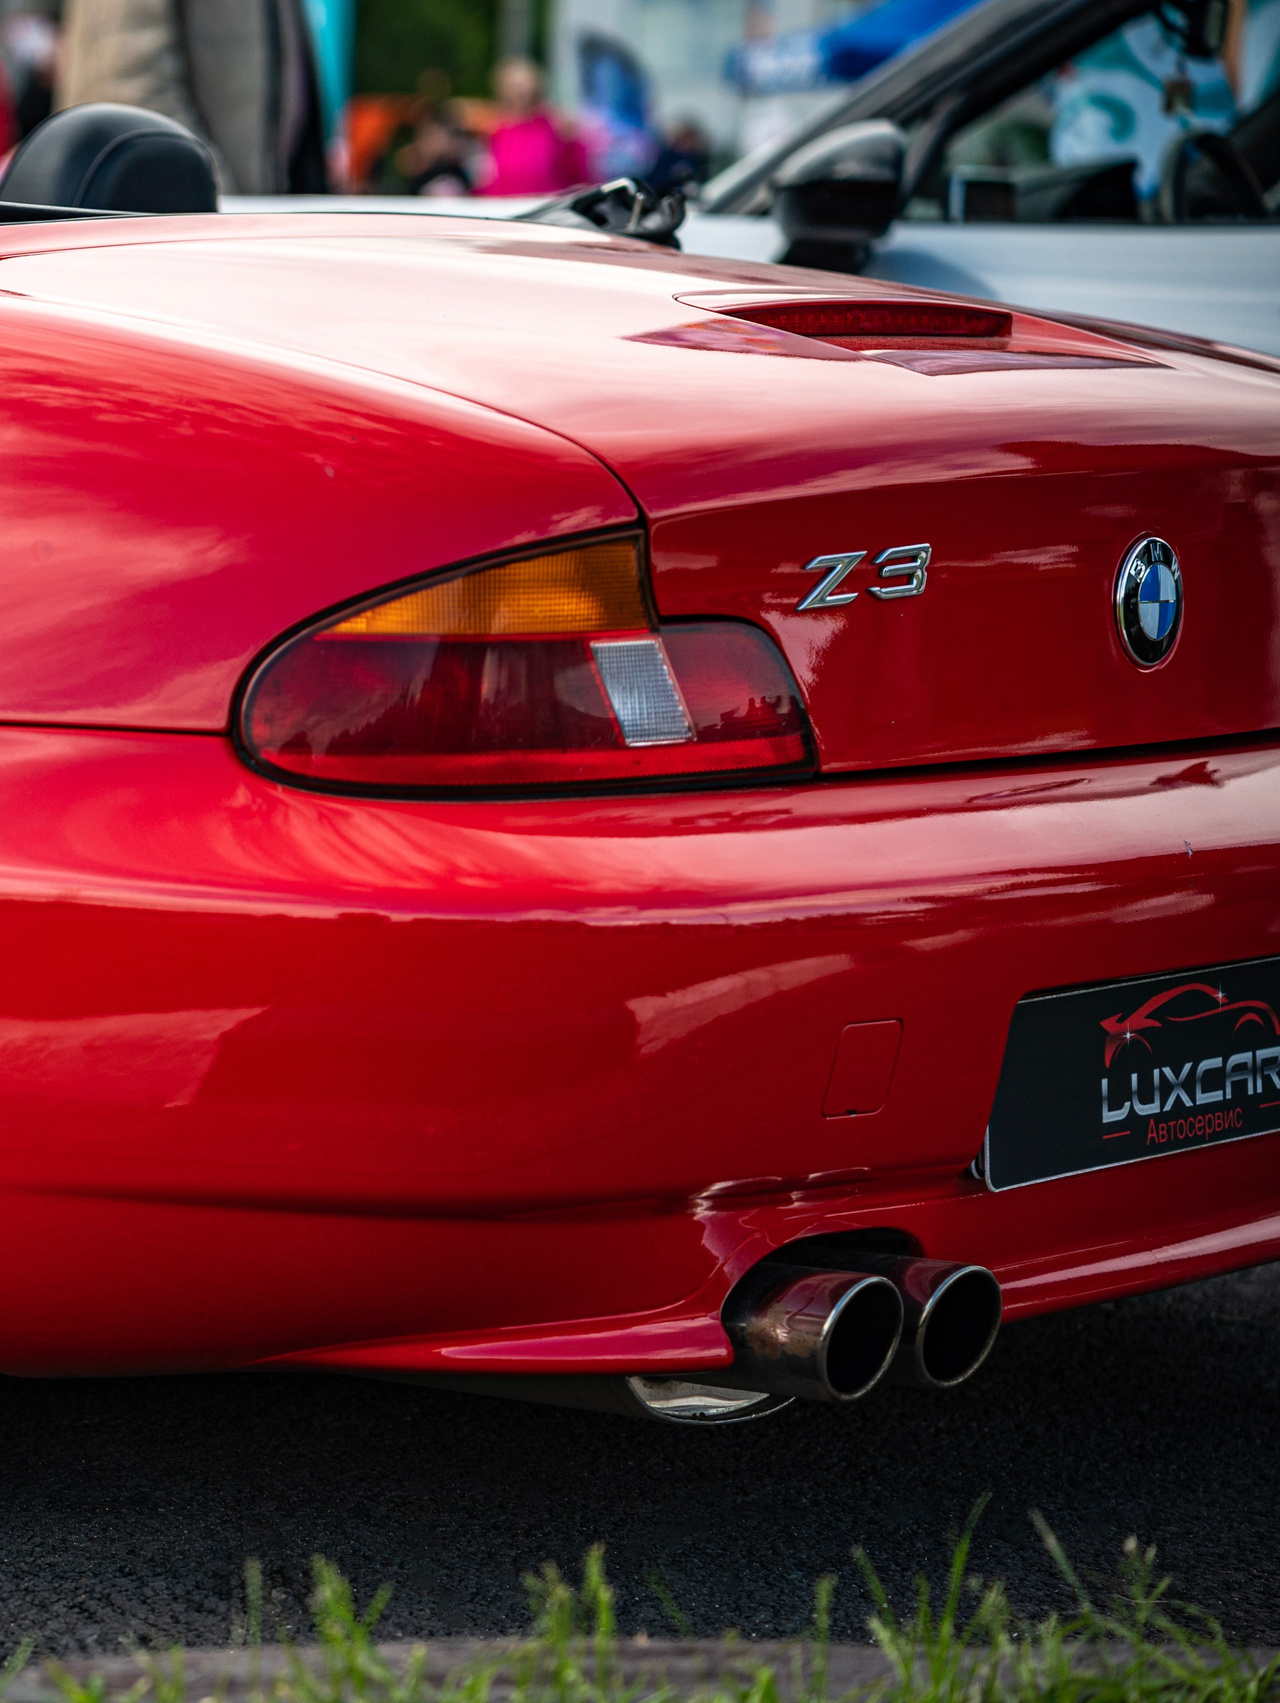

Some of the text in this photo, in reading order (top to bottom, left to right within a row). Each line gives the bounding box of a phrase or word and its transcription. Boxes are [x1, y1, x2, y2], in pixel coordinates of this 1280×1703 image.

[795, 542, 932, 611] Z3
[1129, 542, 1181, 583] BMW
[1101, 1045, 1280, 1124] LUXCAR
[1146, 1107, 1244, 1146] Автосервис
